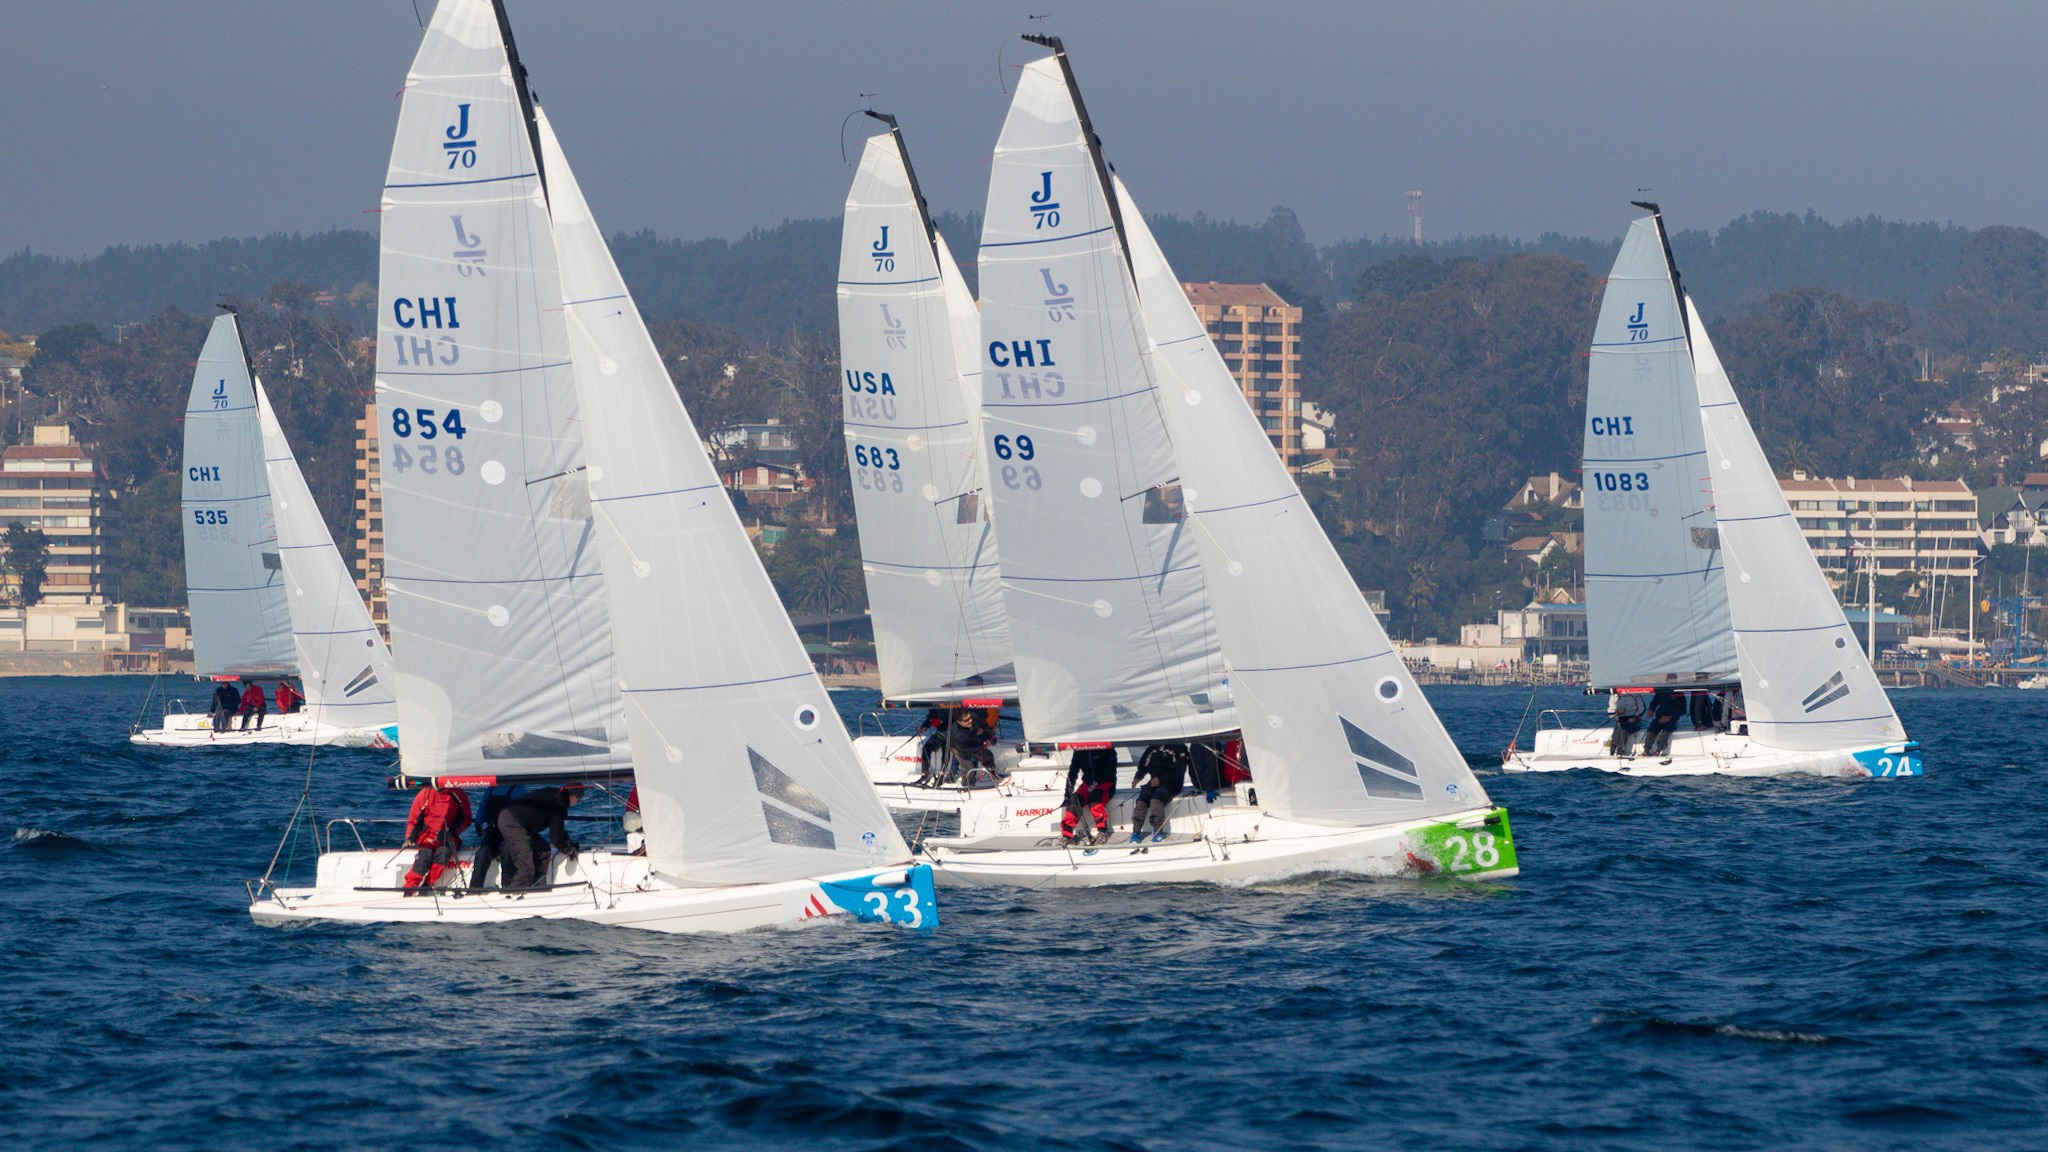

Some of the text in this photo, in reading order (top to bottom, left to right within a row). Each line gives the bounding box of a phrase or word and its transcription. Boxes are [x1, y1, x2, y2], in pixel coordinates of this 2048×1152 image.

[446, 104, 471, 140] J
[447, 150, 477, 170] 70
[1031, 171, 1053, 203] J
[1033, 211, 1060, 230] 70
[873, 226, 889, 251] J
[874, 258, 895, 273] 70
[394, 297, 460, 329] CHI
[1629, 302, 1645, 323] J
[1629, 328, 1648, 342] 70
[989, 339, 1056, 367] CHI
[213, 379, 226, 395] J
[846, 369, 896, 396] USA
[213, 400, 228, 409] 70
[392, 408, 467, 440] 854
[1591, 416, 1634, 436] CHI
[854, 444, 901, 471] 683
[994, 434, 1035, 461] 69
[189, 466, 221, 481] CHI
[1594, 472, 1650, 492] 1083
[194, 510, 228, 525] 535
[1877, 756, 1914, 776] 24
[1000, 806, 1008, 819] J
[1016, 808, 1053, 817] HARKEN
[1445, 831, 1500, 872] 28
[864, 887, 923, 929] 33
